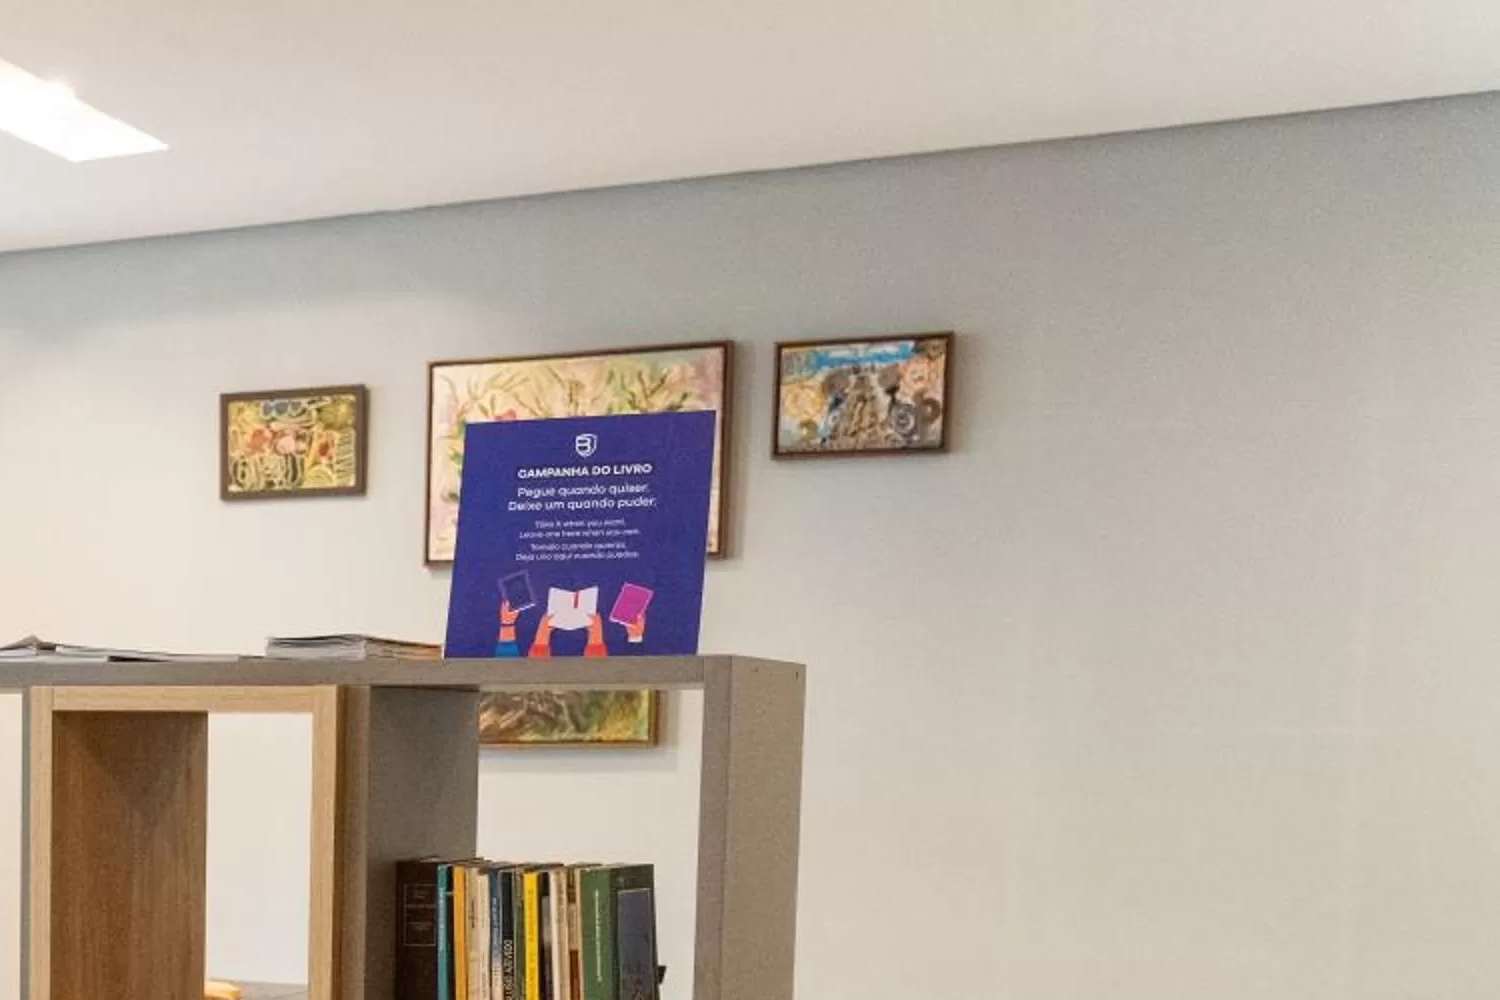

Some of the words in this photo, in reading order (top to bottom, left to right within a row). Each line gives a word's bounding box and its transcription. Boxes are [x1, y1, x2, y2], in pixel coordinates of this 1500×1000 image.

[517, 466, 589, 479] CAMPANHA
[592, 465, 611, 476] DO
[613, 463, 653, 475] LIVRO
[517, 486, 556, 499] Pegue
[557, 484, 607, 497] quando
[608, 482, 649, 496] quiser.
[508, 500, 543, 511] Deixe
[545, 501, 565, 510] um
[567, 498, 615, 511] quando
[617, 496, 657, 509] puder.
